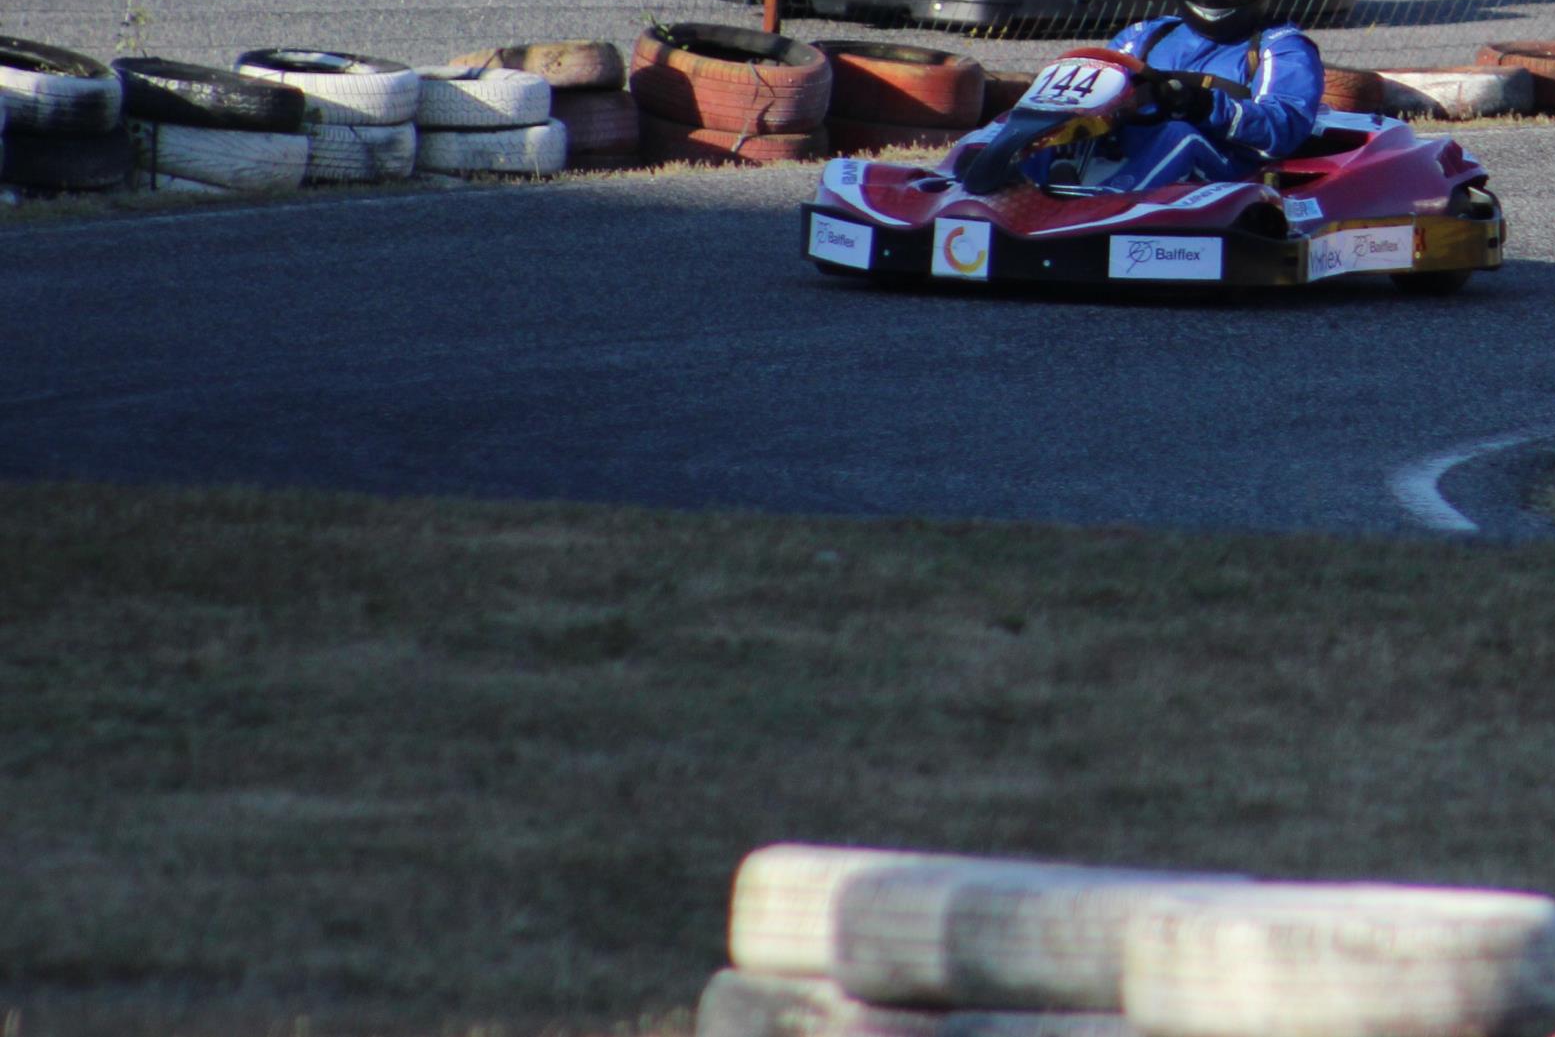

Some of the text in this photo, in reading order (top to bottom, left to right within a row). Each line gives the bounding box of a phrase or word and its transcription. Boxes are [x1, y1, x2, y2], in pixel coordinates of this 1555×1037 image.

[1037, 65, 1103, 98] 144
[1369, 240, 1398, 253] Balflex
[1155, 248, 1201, 261] Balflex
